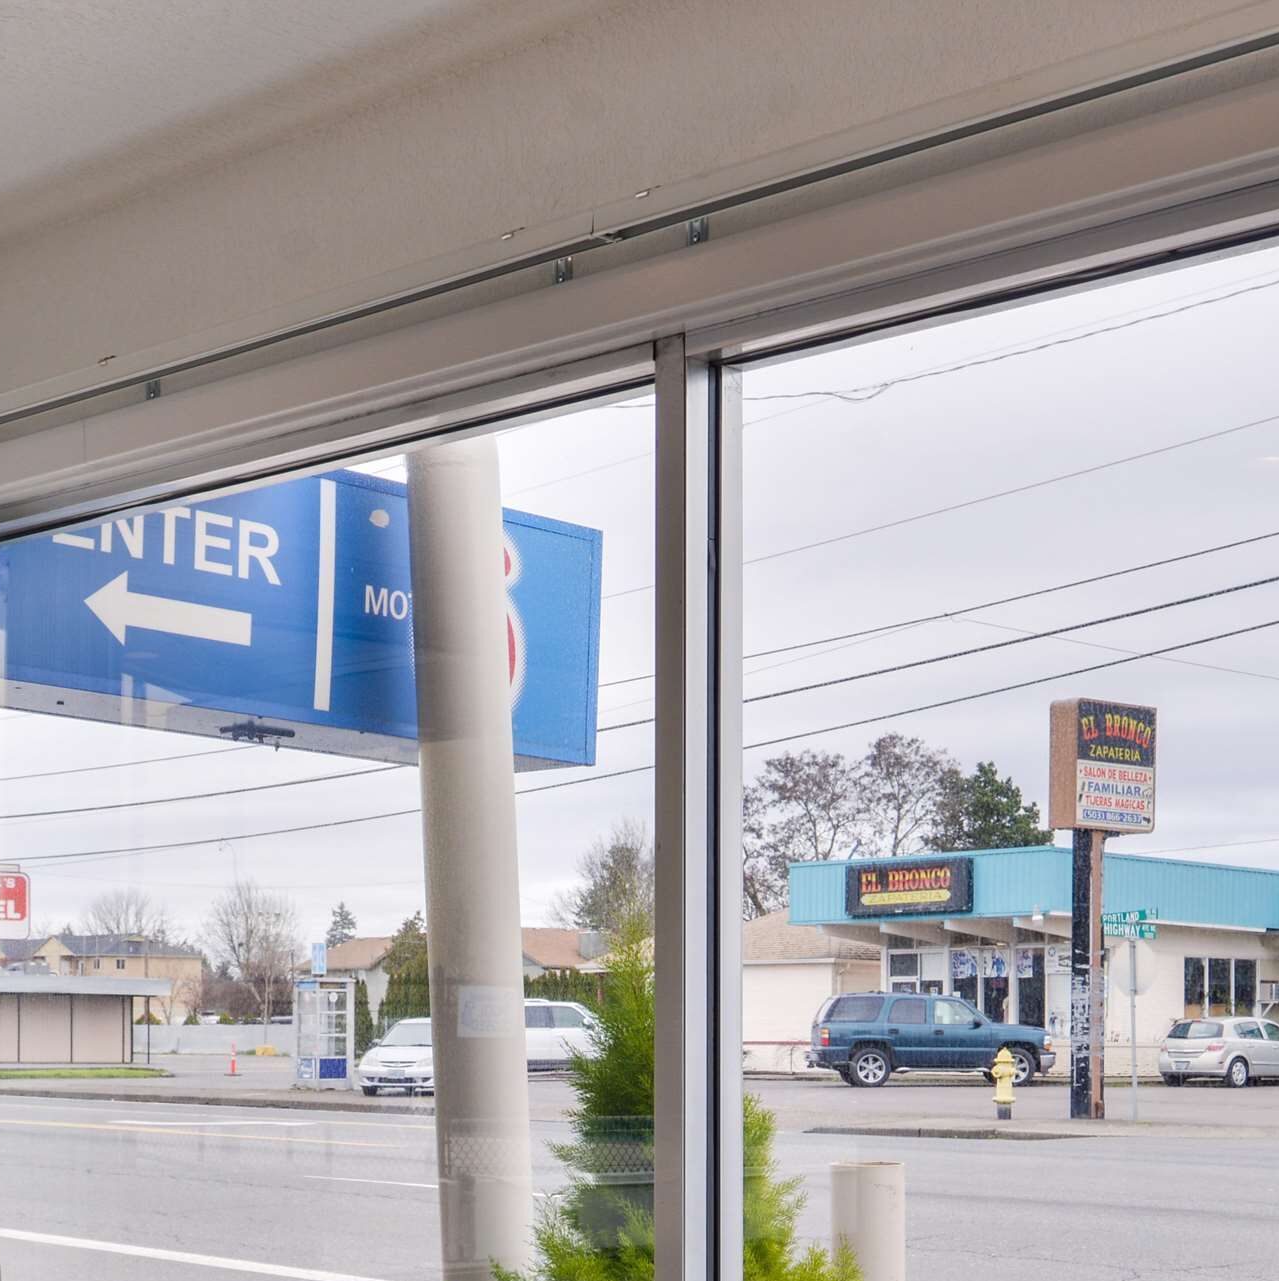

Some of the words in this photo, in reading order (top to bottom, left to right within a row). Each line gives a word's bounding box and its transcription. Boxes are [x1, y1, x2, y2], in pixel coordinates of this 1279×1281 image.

[53, 506, 282, 586] NTER
[364, 584, 412, 620] MO
[1082, 715, 1099, 741] EL
[1105, 713, 1152, 748] BRONCO
[1089, 744, 1141, 761] ZAPATERIA
[1083, 766, 1106, 778] SALON
[1108, 769, 1117, 780] DE
[1119, 770, 1148, 783] BELLEZA
[1087, 781, 1141, 797] FAMILIAR
[1114, 798, 1145, 811] MAGICAS
[861, 871, 881, 893] EL
[888, 866, 951, 891] BRONCO
[1102, 911, 1139, 921] PORTLAND
[1103, 923, 1140, 937] HIGHWAY
